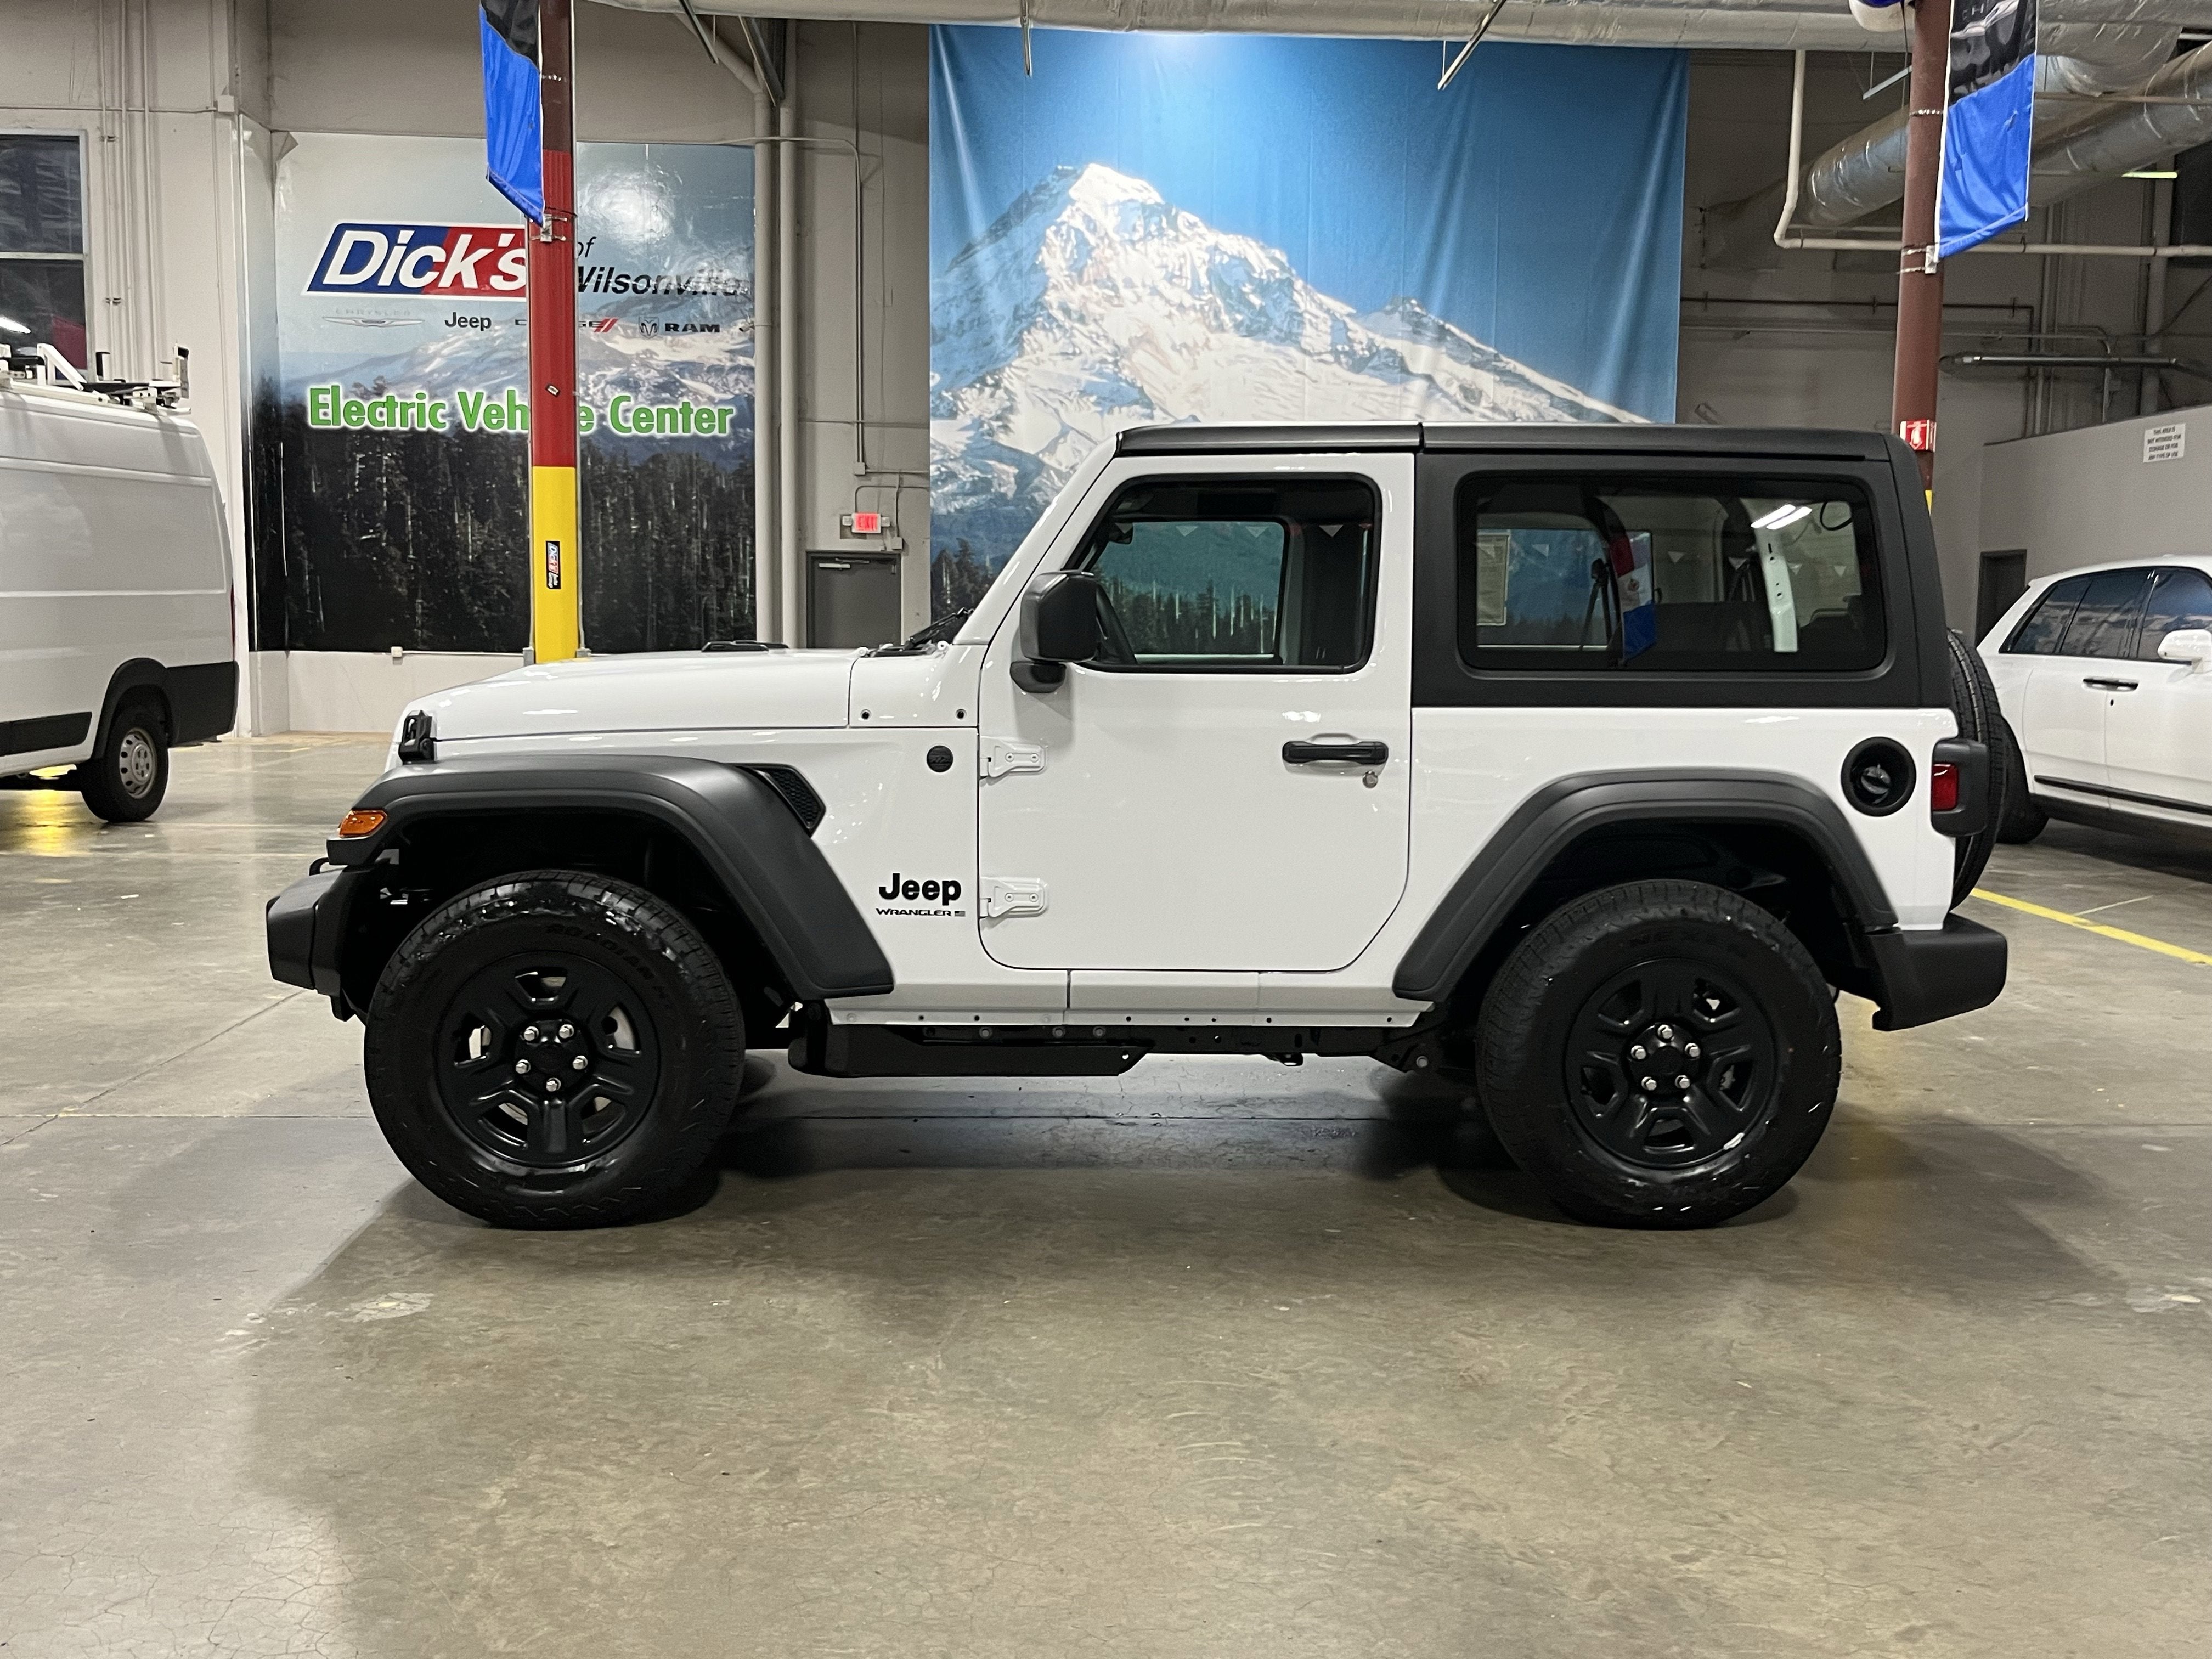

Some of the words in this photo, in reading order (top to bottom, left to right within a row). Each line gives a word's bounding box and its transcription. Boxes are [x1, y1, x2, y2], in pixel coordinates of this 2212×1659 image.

[323, 230, 526, 291] Dick's
[578, 266, 747, 295] Wilsonv
[444, 312, 492, 331] Jeep
[664, 323, 720, 333] RAM
[310, 385, 447, 429] Electric
[458, 390, 595, 432] Vehe
[610, 395, 734, 434] Center
[878, 873, 961, 906] Jeep
[876, 908, 951, 916] WRANGLER
